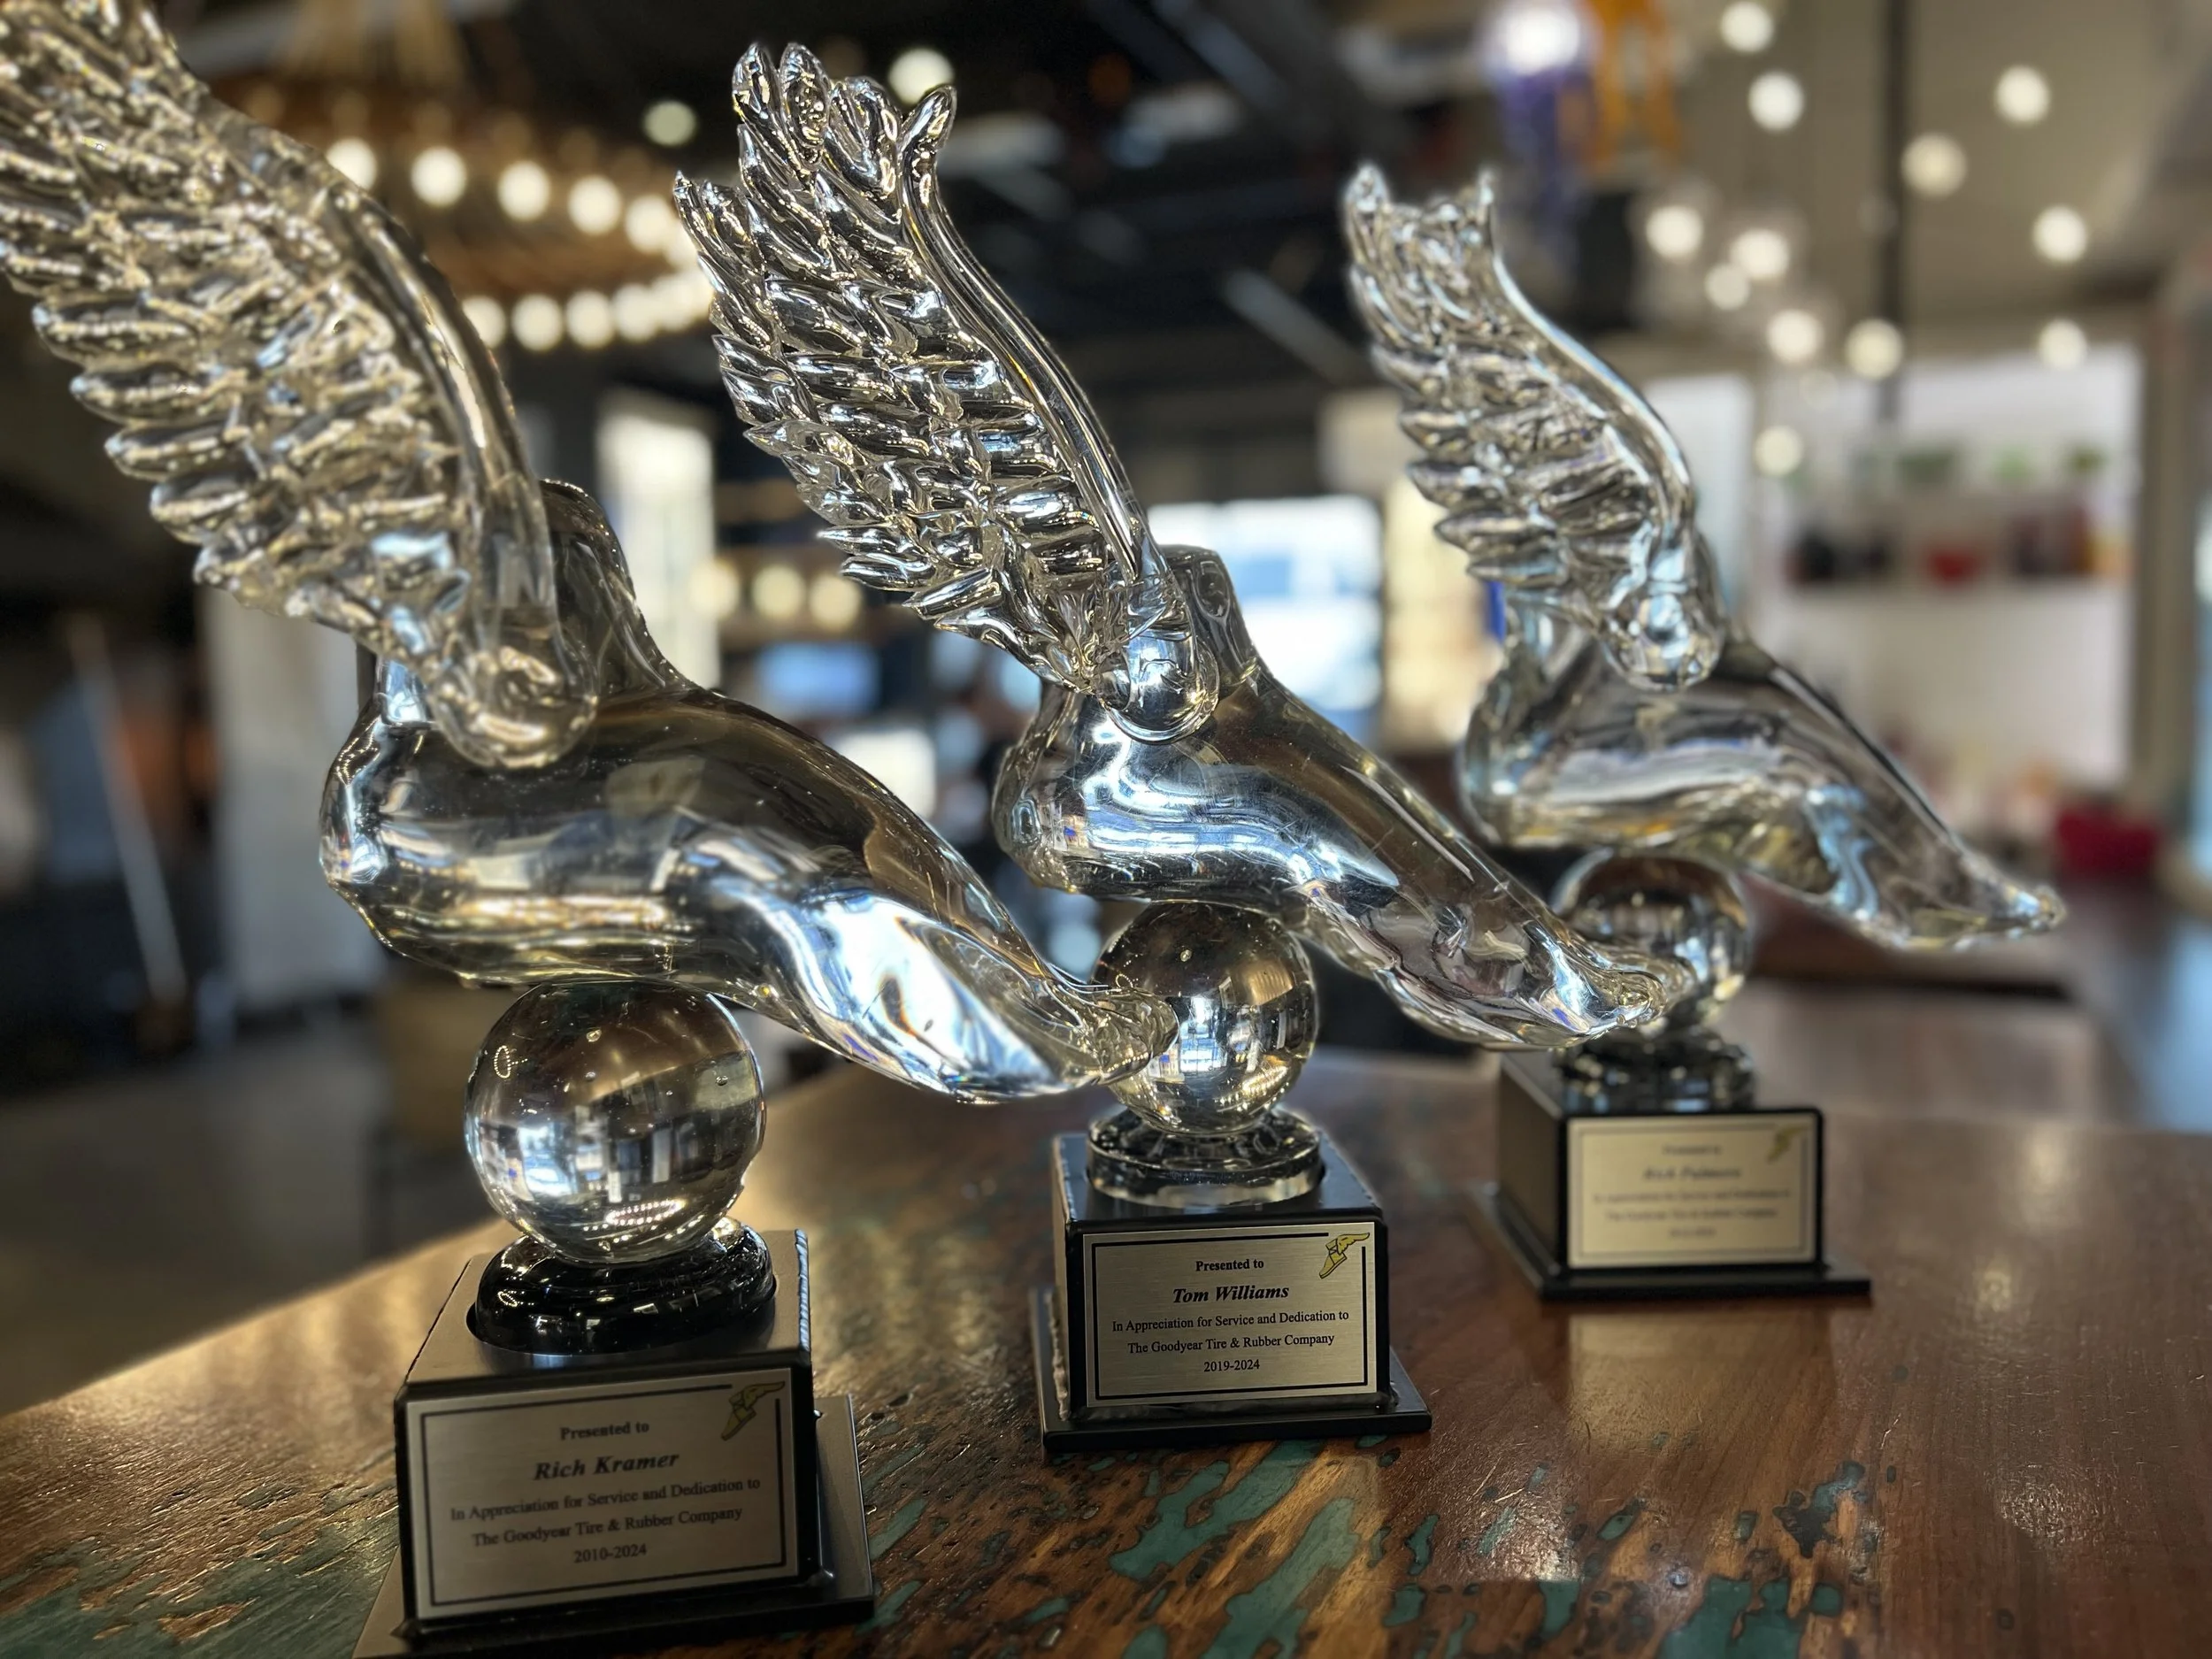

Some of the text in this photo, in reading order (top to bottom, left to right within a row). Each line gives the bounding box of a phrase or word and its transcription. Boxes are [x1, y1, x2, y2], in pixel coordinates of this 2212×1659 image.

[1196, 1259, 1263, 1271] Presented to
[1173, 1285, 1289, 1302] Tom Williams
[1113, 1321, 1123, 1332] In
[1125, 1317, 1194, 1333] Appreciation
[1197, 1317, 1213, 1327] for
[1216, 1316, 1255, 1326] Service
[1257, 1313, 1276, 1324] and
[1279, 1311, 1335, 1323] Dedication
[1127, 1334, 1334, 1354] The Goodyear Tire & Rubber Company
[1204, 1359, 1260, 1371] 2019-2024
[560, 1422, 649, 1440] Presented to
[534, 1455, 680, 1480] Rich Kramer
[450, 1479, 760, 1522] In Appreciation for Service and Dedication to
[472, 1509, 742, 1547] The Goodyear Tire & Rubber Company
[573, 1543, 647, 1563] 2010-2024
